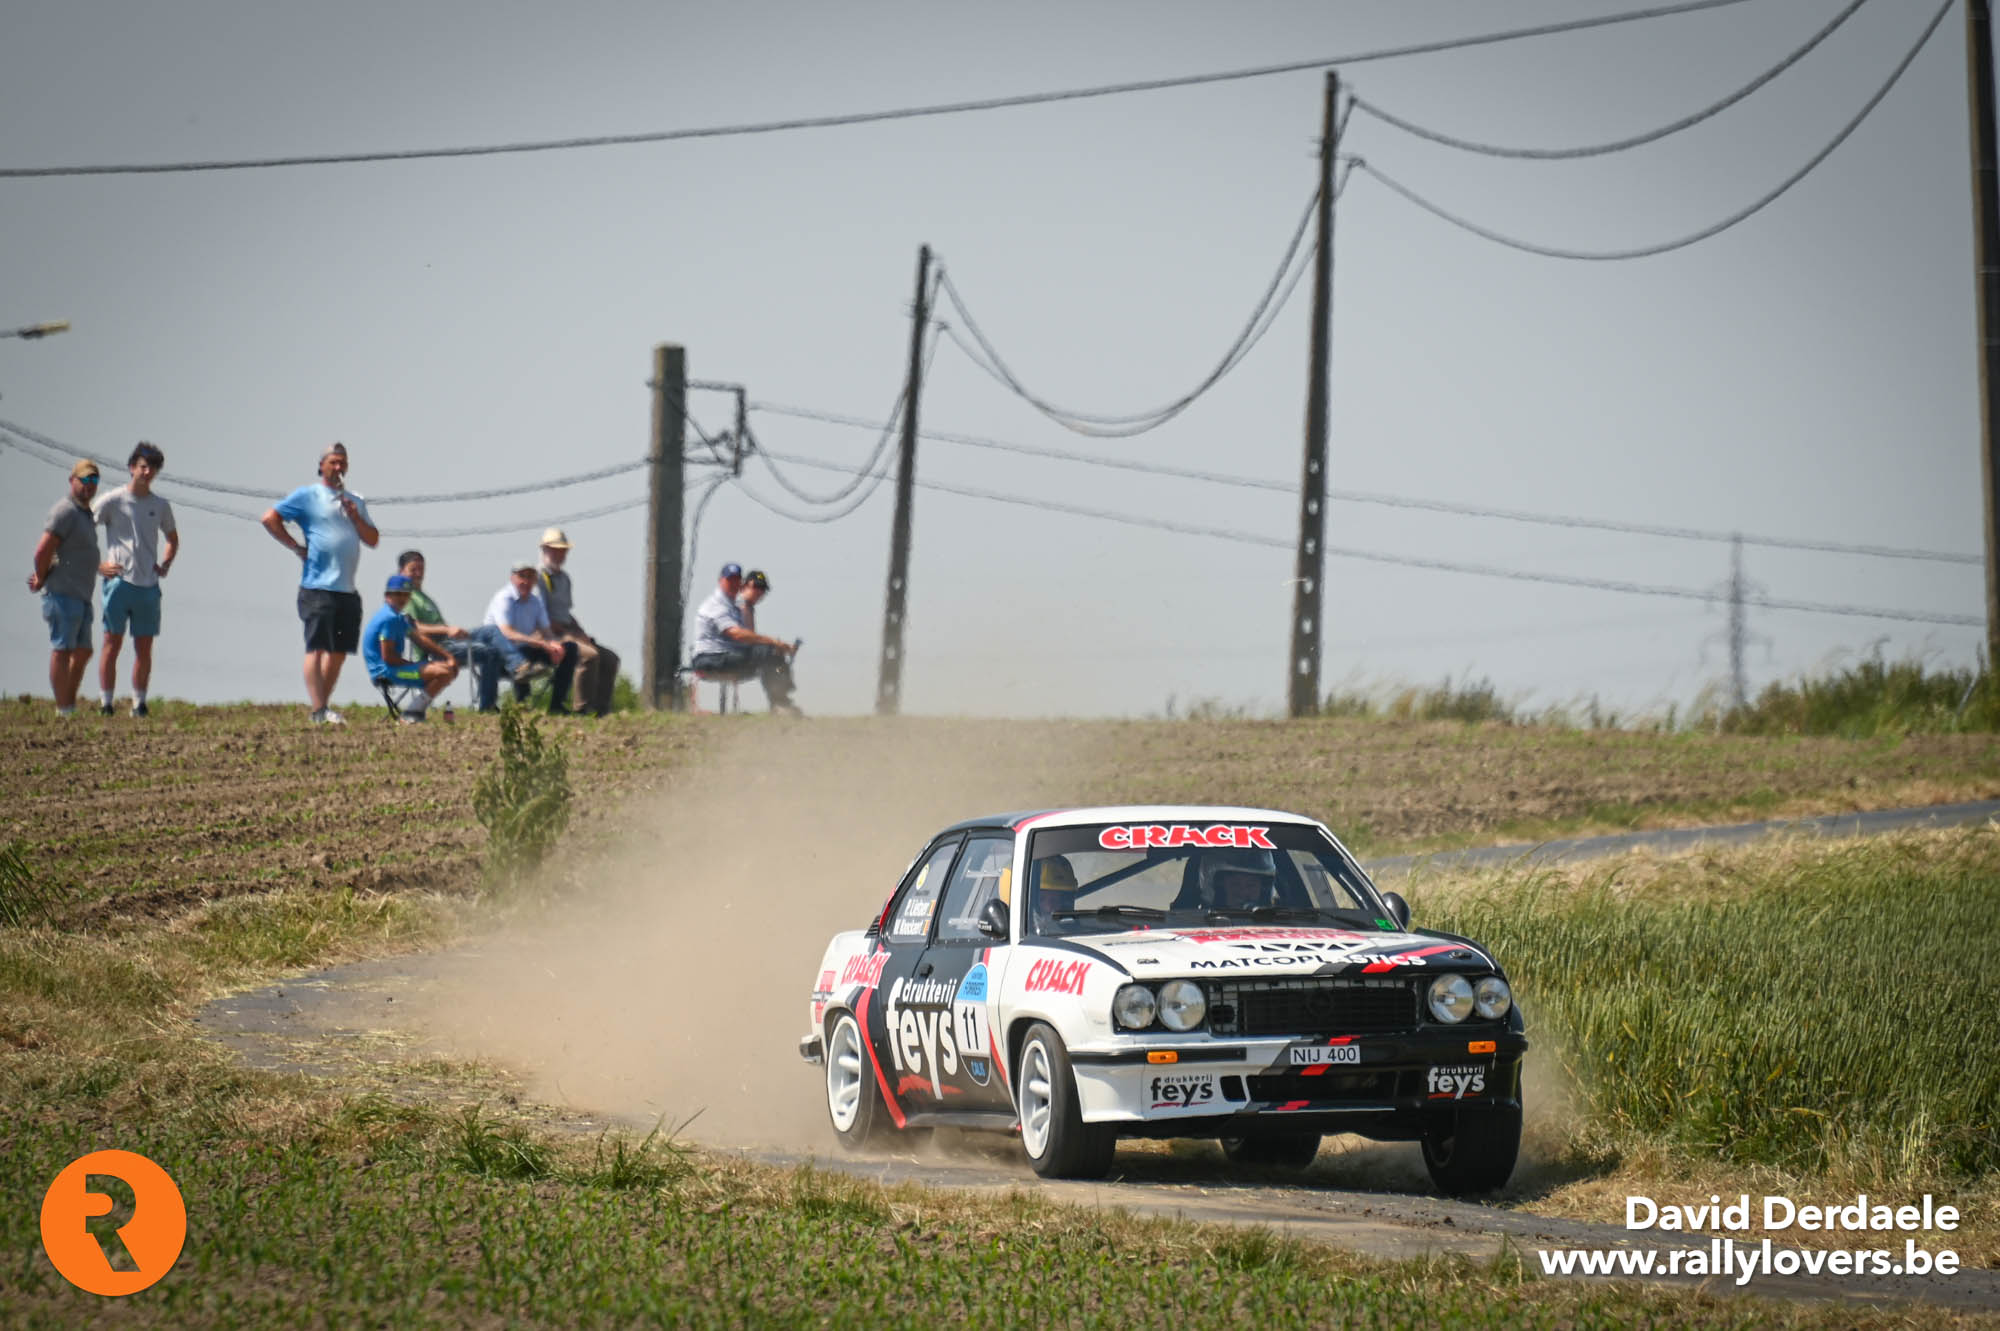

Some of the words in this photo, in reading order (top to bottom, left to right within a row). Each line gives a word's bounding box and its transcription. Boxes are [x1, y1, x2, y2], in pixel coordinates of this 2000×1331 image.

[1099, 825, 1277, 849] CRACK
[841, 952, 891, 988] CRACK
[1191, 952, 1426, 969] MATCOPLASTICS
[1025, 958, 1092, 996] CRACK
[902, 978, 957, 1009] drukkerij
[886, 977, 957, 1100] feys
[963, 1006, 979, 1050] 11
[1293, 1048, 1321, 1063] NIJ
[1327, 1047, 1357, 1062] 400
[1440, 1065, 1485, 1075] drukkerij
[1150, 1076, 1214, 1108] feys
[1164, 1074, 1213, 1084] drukkerij
[1427, 1067, 1485, 1100] feys
